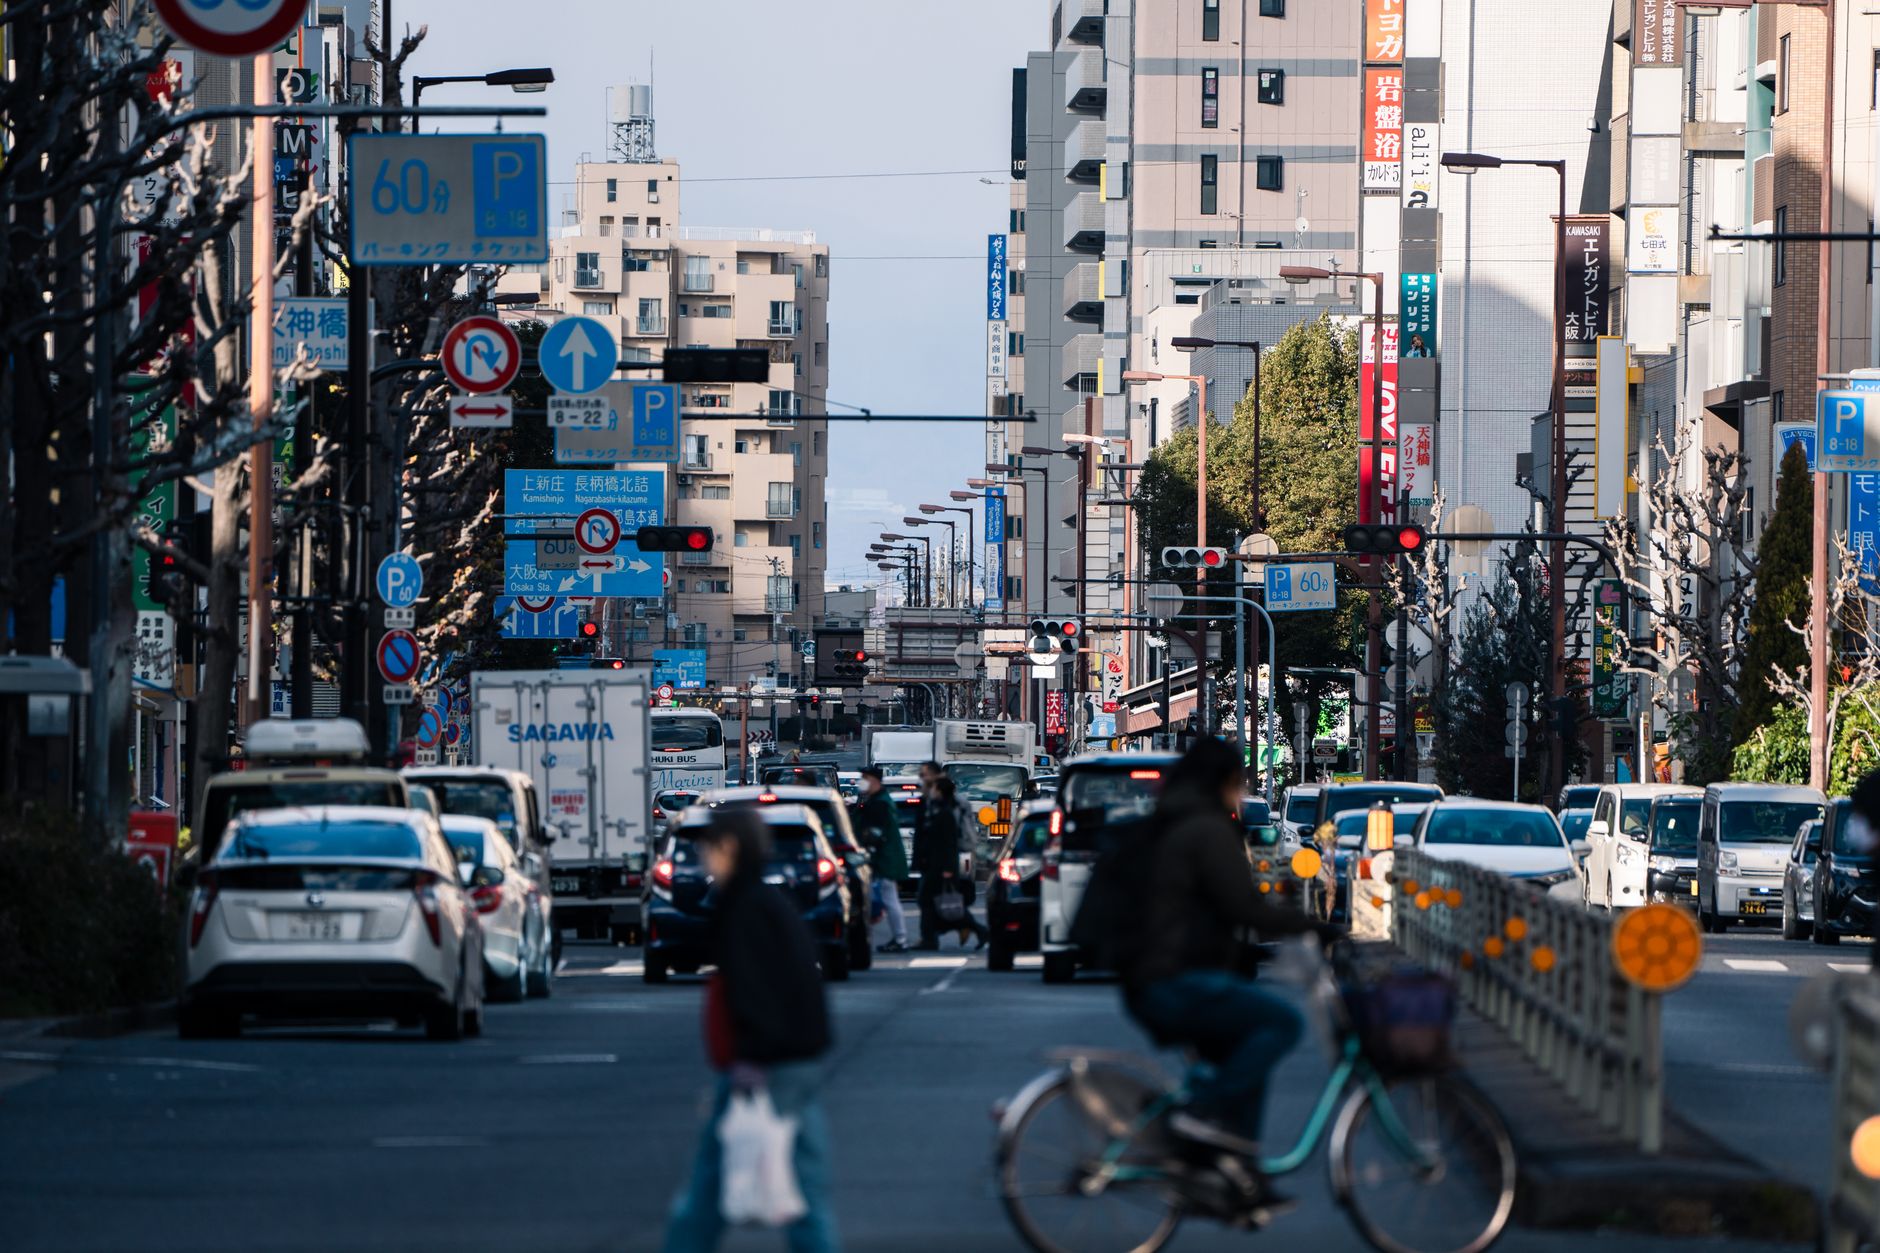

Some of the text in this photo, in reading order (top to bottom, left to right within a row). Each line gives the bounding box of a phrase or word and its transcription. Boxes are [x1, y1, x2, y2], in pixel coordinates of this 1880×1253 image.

[1374, 76, 1402, 158] 岩盤浴
[493, 151, 523, 200] P
[371, 158, 450, 215] 60分
[1565, 226, 1601, 236] KAWASAKI
[1640, 240, 1667, 249] 七田式
[1583, 238, 1601, 341] エレガントビル
[1407, 275, 1419, 332] エンリケ
[1421, 275, 1431, 332] セルフエステ
[1565, 311, 1579, 340] 大阪
[645, 391, 666, 423] P
[1836, 401, 1857, 433] P
[1416, 426, 1431, 466] 天神橋
[1829, 437, 1857, 451] 8-18
[521, 475, 649, 493] 上新庄 長柄橋北詰
[522, 493, 648, 505] Kamishinjo Nagarabashi-kitazume
[387, 567, 405, 601] P
[510, 583, 552, 592] Osaka Sta.
[1275, 570, 1286, 590] P
[1300, 571, 1329, 592] 60分
[399, 586, 412, 602] 60
[1271, 590, 1288, 600] 8-18
[508, 722, 614, 742] SAGAWA
[676, 755, 697, 763] BUS
